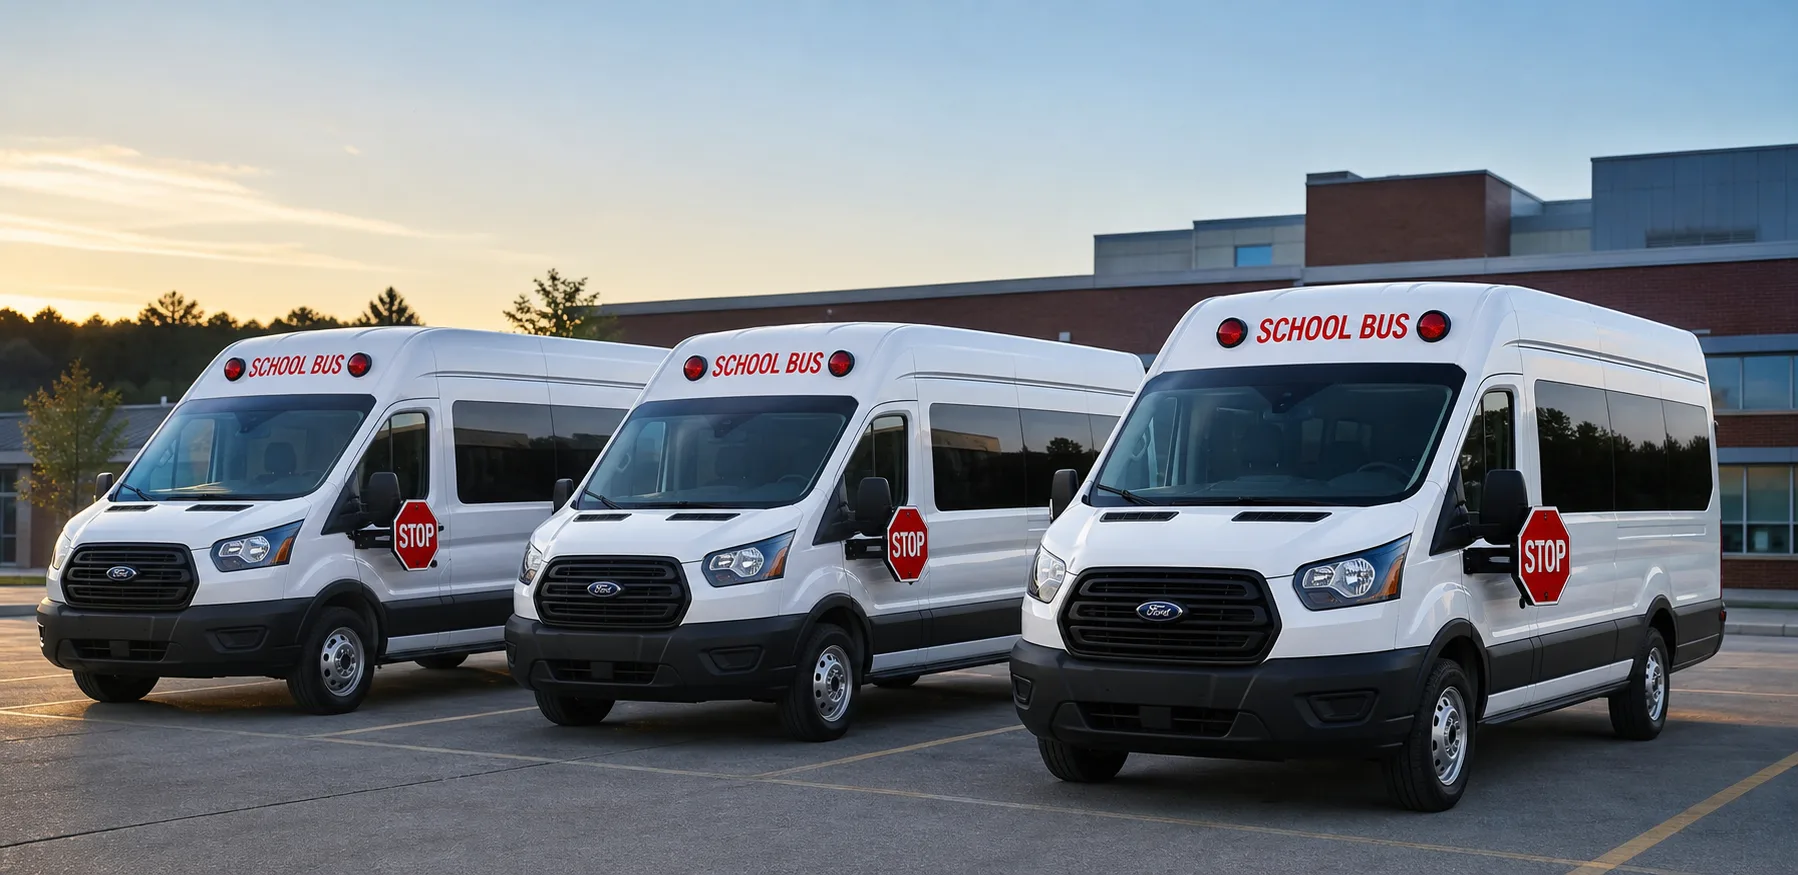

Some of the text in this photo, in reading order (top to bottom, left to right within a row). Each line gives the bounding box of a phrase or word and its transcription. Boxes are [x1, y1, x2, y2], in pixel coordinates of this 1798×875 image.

[1256, 313, 1410, 344] SCHOOL BUS
[248, 354, 344, 378] SCHOOL BUS
[712, 351, 824, 377] SCHOOL BUS
[398, 523, 435, 549] STOP
[892, 531, 925, 558] STOP
[1524, 539, 1566, 574] STOP
